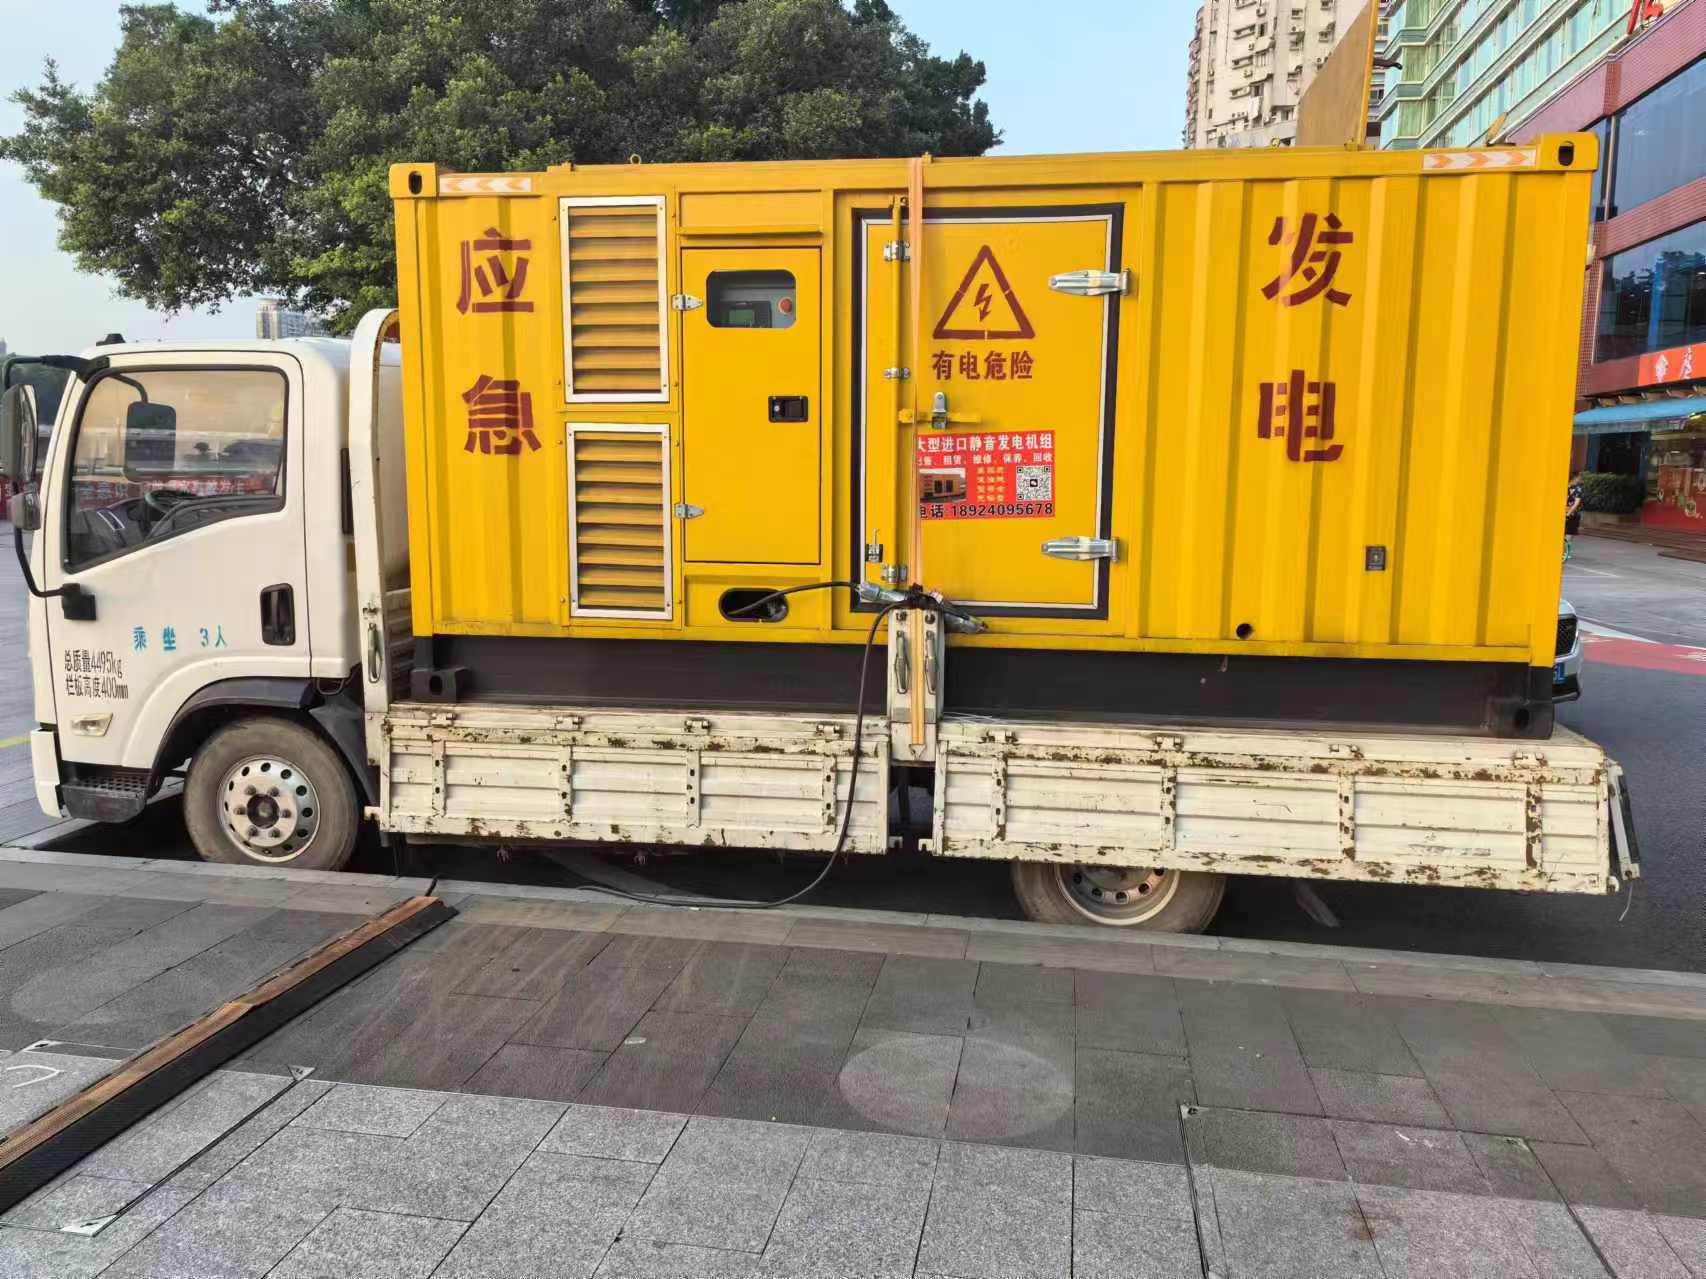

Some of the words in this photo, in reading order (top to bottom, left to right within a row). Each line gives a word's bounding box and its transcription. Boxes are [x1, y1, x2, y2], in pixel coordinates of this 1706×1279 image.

[456, 227, 542, 455] 应急
[1257, 212, 1354, 462] 发电
[931, 349, 1035, 381] 有电危险
[917, 432, 1053, 453] 大型进口静音发电机组
[951, 503, 1053, 518] 18924095678
[64, 648, 124, 680] 总质量4495kg
[65, 674, 129, 700] 栏板高度400mm
